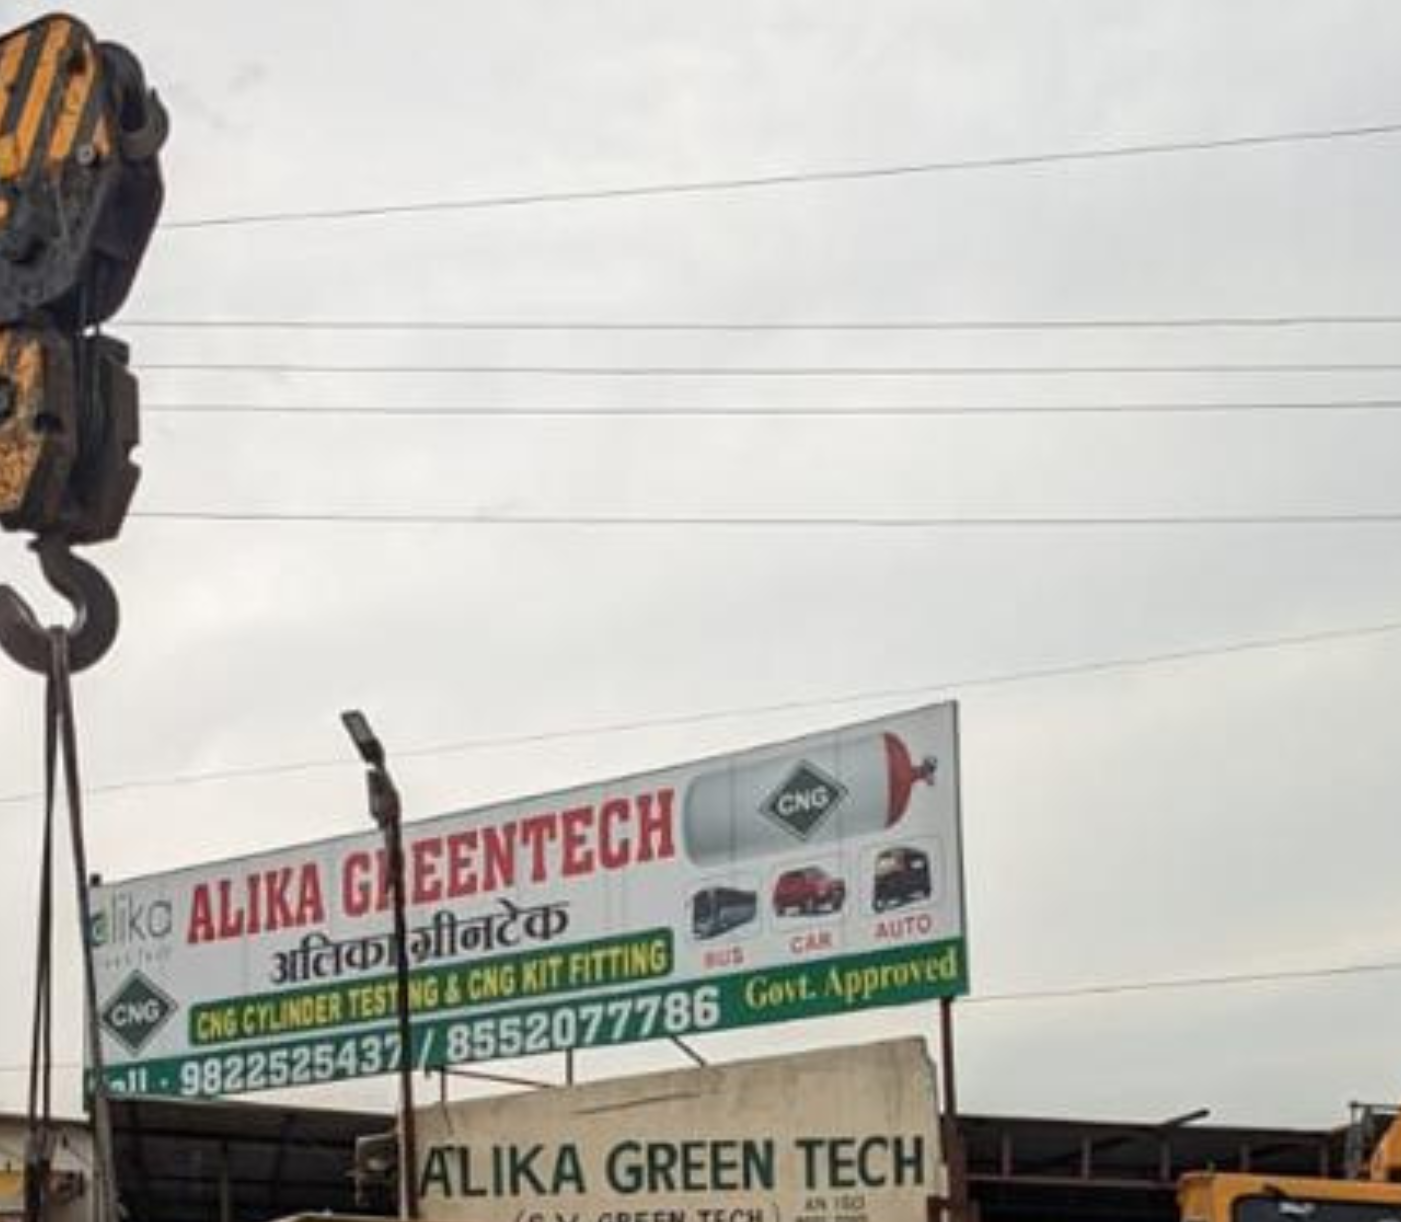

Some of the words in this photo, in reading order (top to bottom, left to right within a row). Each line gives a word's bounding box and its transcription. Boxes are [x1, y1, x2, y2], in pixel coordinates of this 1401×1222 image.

[776, 786, 829, 815] CNG
[187, 863, 325, 944] ALIKA
[789, 932, 833, 955] CAR
[874, 914, 933, 940] AUTO
[703, 946, 745, 970] BUS
[745, 976, 817, 1008] Govt.
[824, 945, 958, 1004] Approved
[198, 1007, 238, 1040] CNG
[243, 989, 341, 1033] CYLINDER
[348, 976, 438, 1015] TESTNG
[444, 974, 461, 1004] &
[467, 964, 515, 999] CNG
[523, 956, 564, 992] KIT
[569, 939, 667, 986] FITTING
[111, 1000, 160, 1027] CNG
[180, 1035, 402, 1095] 9822525437
[417, 1030, 433, 1070] /
[447, 985, 720, 1062] 8552077786
[419, 1142, 587, 1198] ALIKA
[605, 1138, 775, 1195] GREEN
[794, 1134, 925, 1190] TECH
